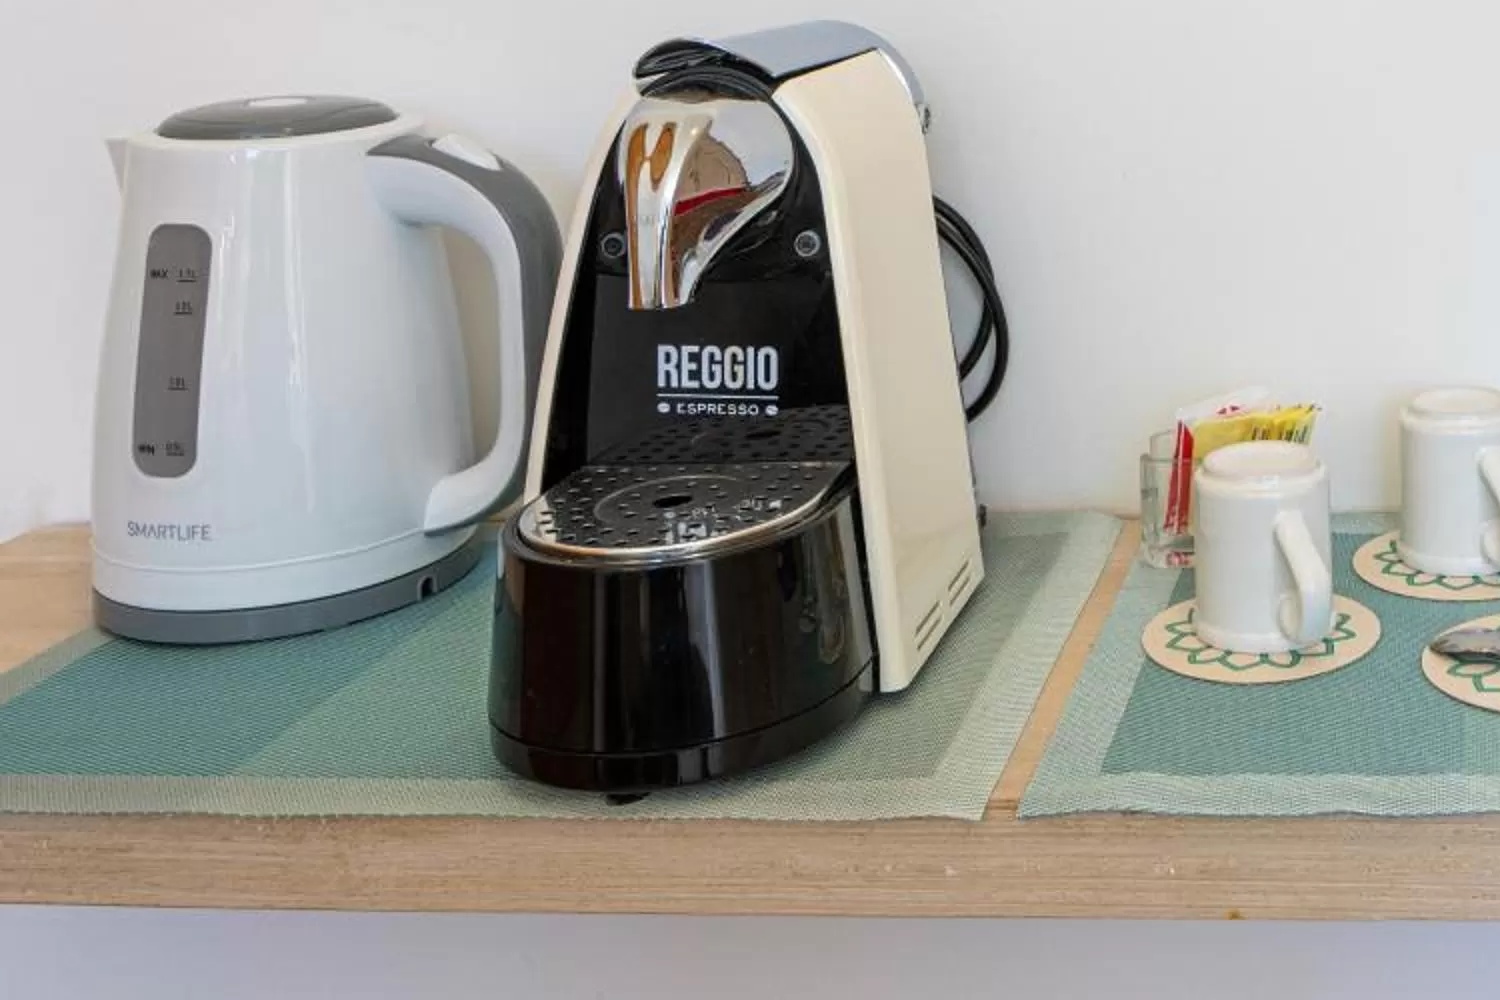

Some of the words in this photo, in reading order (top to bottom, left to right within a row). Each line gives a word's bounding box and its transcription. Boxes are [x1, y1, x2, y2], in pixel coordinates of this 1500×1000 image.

[657, 344, 779, 390] REGGIO
[677, 402, 759, 416] ESPRESSO
[127, 520, 212, 542] SMARTLIFE
